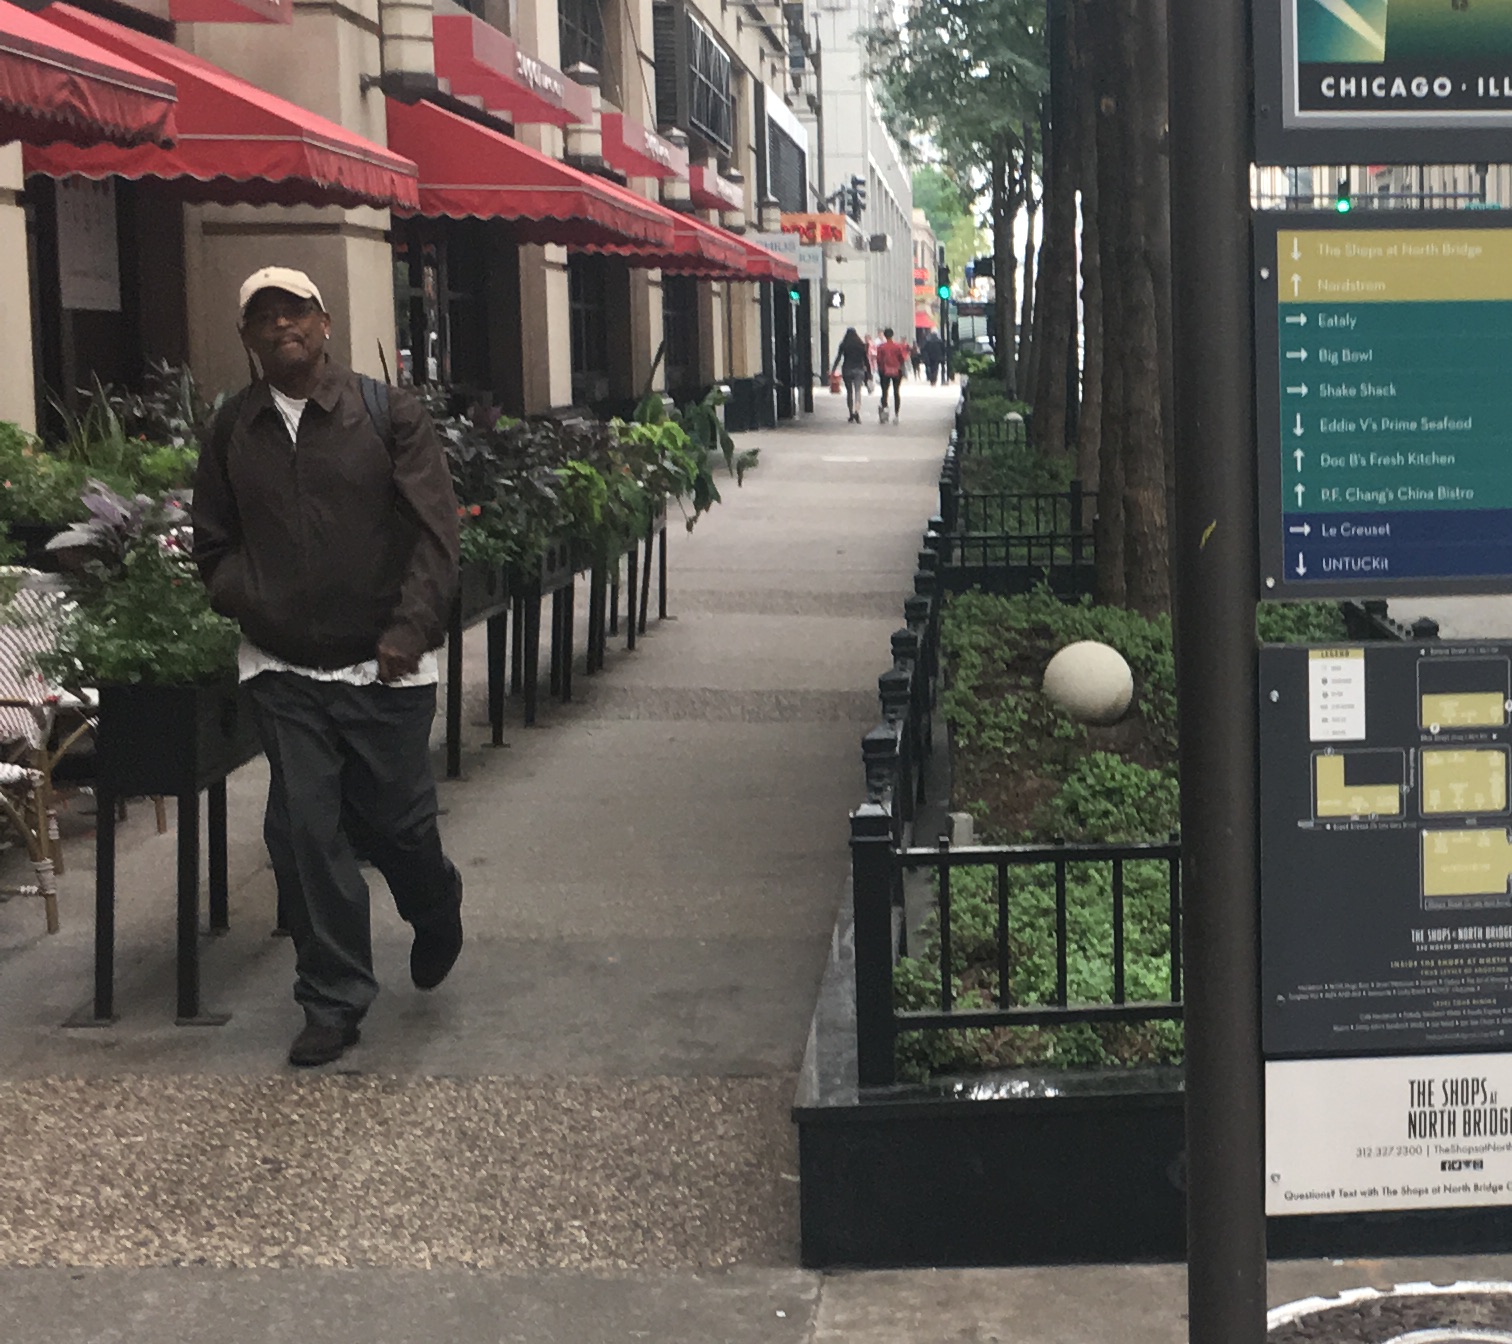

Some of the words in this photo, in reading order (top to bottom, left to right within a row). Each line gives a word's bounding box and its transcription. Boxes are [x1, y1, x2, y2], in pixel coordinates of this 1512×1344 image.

[1320, 75, 1452, 98] CHICAGO
[1402, 242, 1438, 256] North
[1443, 242, 1482, 259] Bridge
[1318, 279, 1386, 292] Nordstrom
[1319, 312, 1357, 330] Eataly
[1319, 348, 1338, 366] Big
[1342, 348, 1373, 362] Bowl
[1319, 382, 1356, 397] Shake
[1360, 382, 1396, 397] Shack
[1320, 417, 1356, 433] Eddie
[1381, 416, 1417, 431] Prime
[1421, 416, 1472, 431] Seafood
[1320, 452, 1345, 468] Doc
[1370, 451, 1404, 466] Fresh
[1408, 451, 1455, 465] Kitchen
[1345, 487, 1394, 504] Chang's
[1397, 486, 1434, 501] China
[1437, 485, 1474, 500] Bistro
[1321, 523, 1337, 537] Le
[1340, 521, 1391, 537] Creuset
[1411, 928, 1424, 943] THE
[1427, 927, 1451, 942] SHOPS
[1457, 926, 1483, 941] NORTH
[1485, 925, 1512, 940] BRIDGE
[1408, 1078, 1435, 1108] THE
[1441, 1076, 1488, 1107] SHOPS
[1407, 1108, 1457, 1140] NORTH
[1444, 1183, 1471, 1194] North
[1473, 1182, 1504, 1195] Bridge
